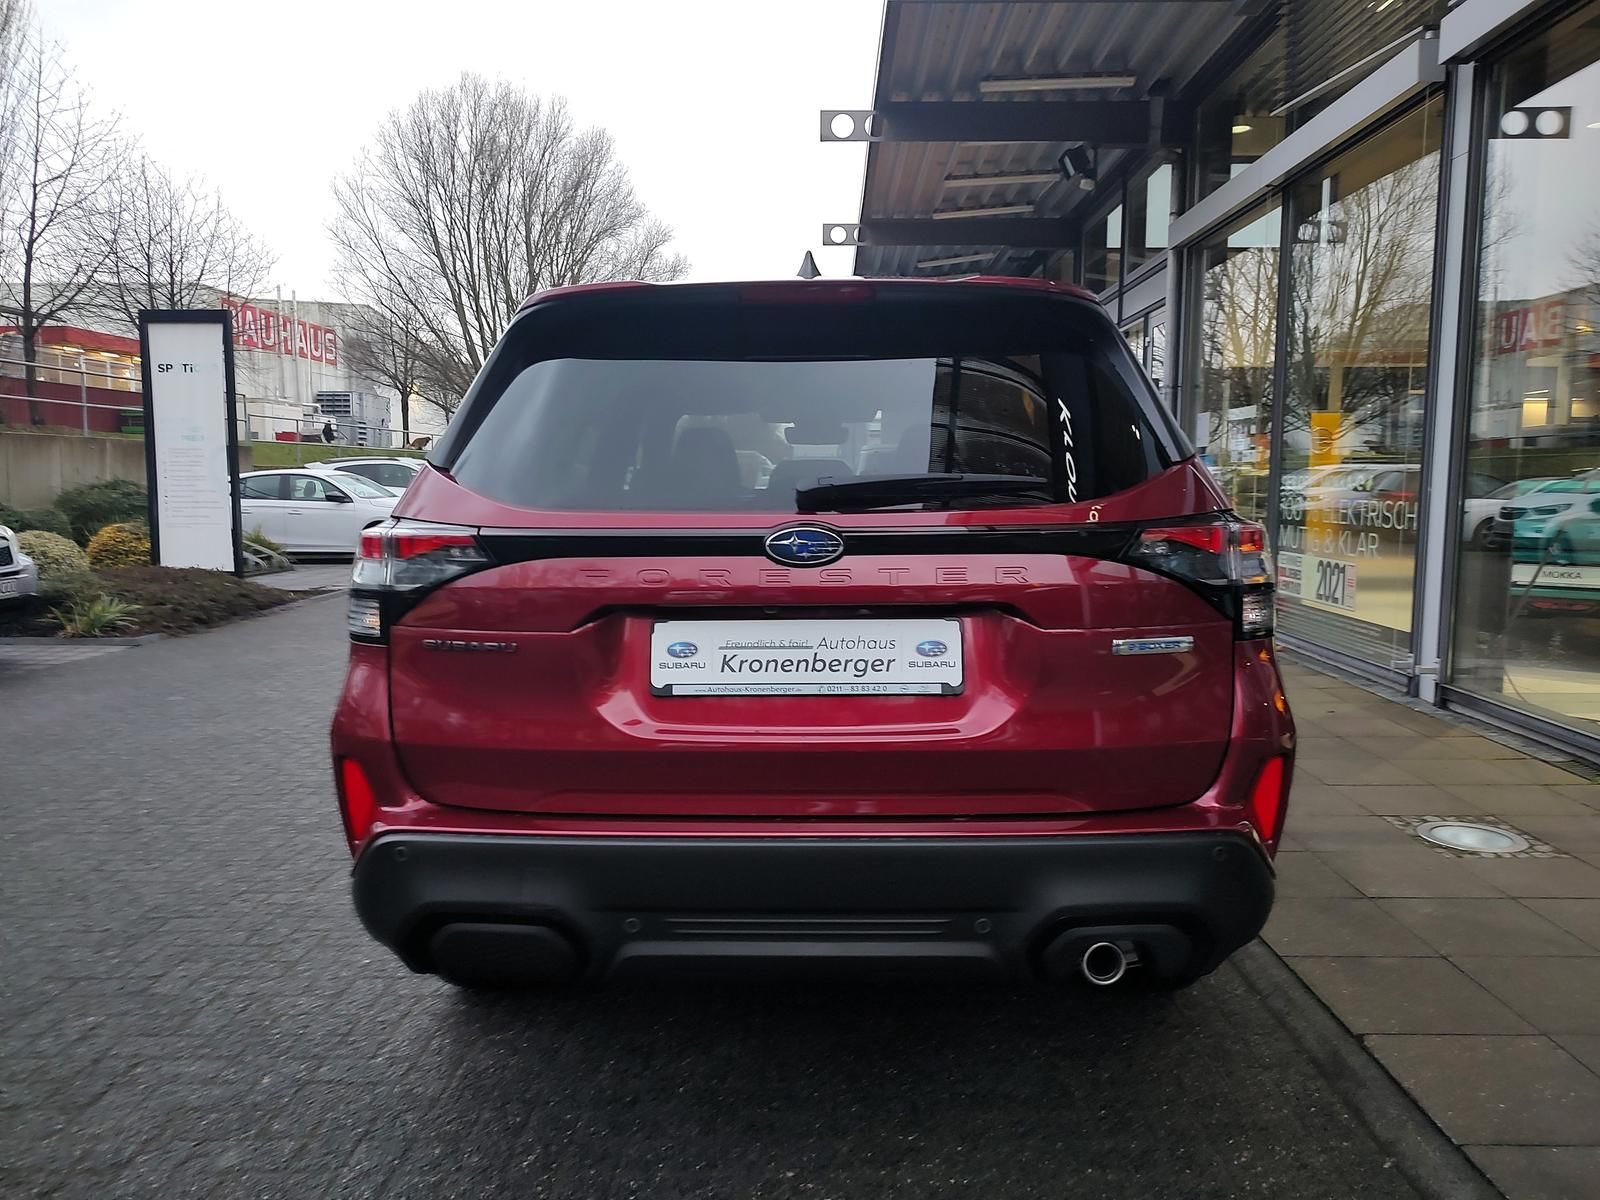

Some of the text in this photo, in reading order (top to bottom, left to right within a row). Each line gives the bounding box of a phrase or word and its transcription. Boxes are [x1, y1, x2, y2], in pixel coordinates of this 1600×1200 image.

[1339, 530, 1379, 559] KLAR
[578, 565, 1031, 587] FORESTER
[1315, 559, 1346, 606] 2021
[1542, 570, 1582, 579] MOKKA
[725, 635, 896, 650] Freundlich & fair! Autohaus
[720, 652, 896, 678] Kronenberger
